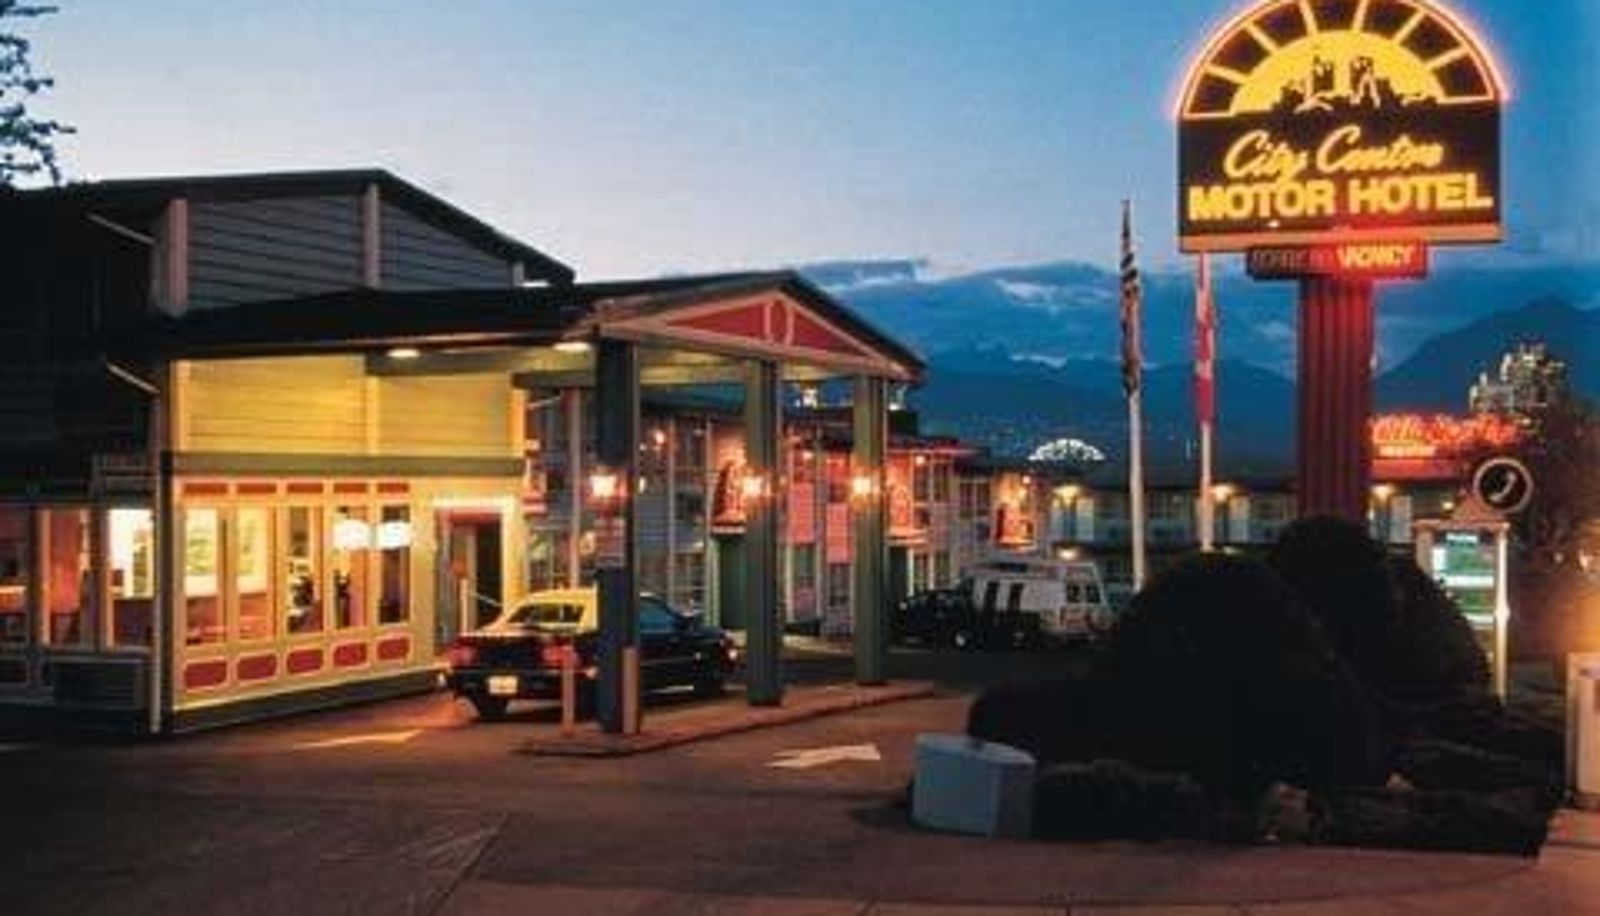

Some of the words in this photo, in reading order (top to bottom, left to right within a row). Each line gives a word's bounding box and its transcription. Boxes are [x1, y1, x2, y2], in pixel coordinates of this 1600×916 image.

[1223, 129, 1308, 182] City
[1189, 179, 1335, 221] MOTOR
[1348, 172, 1495, 215] HOTEL
